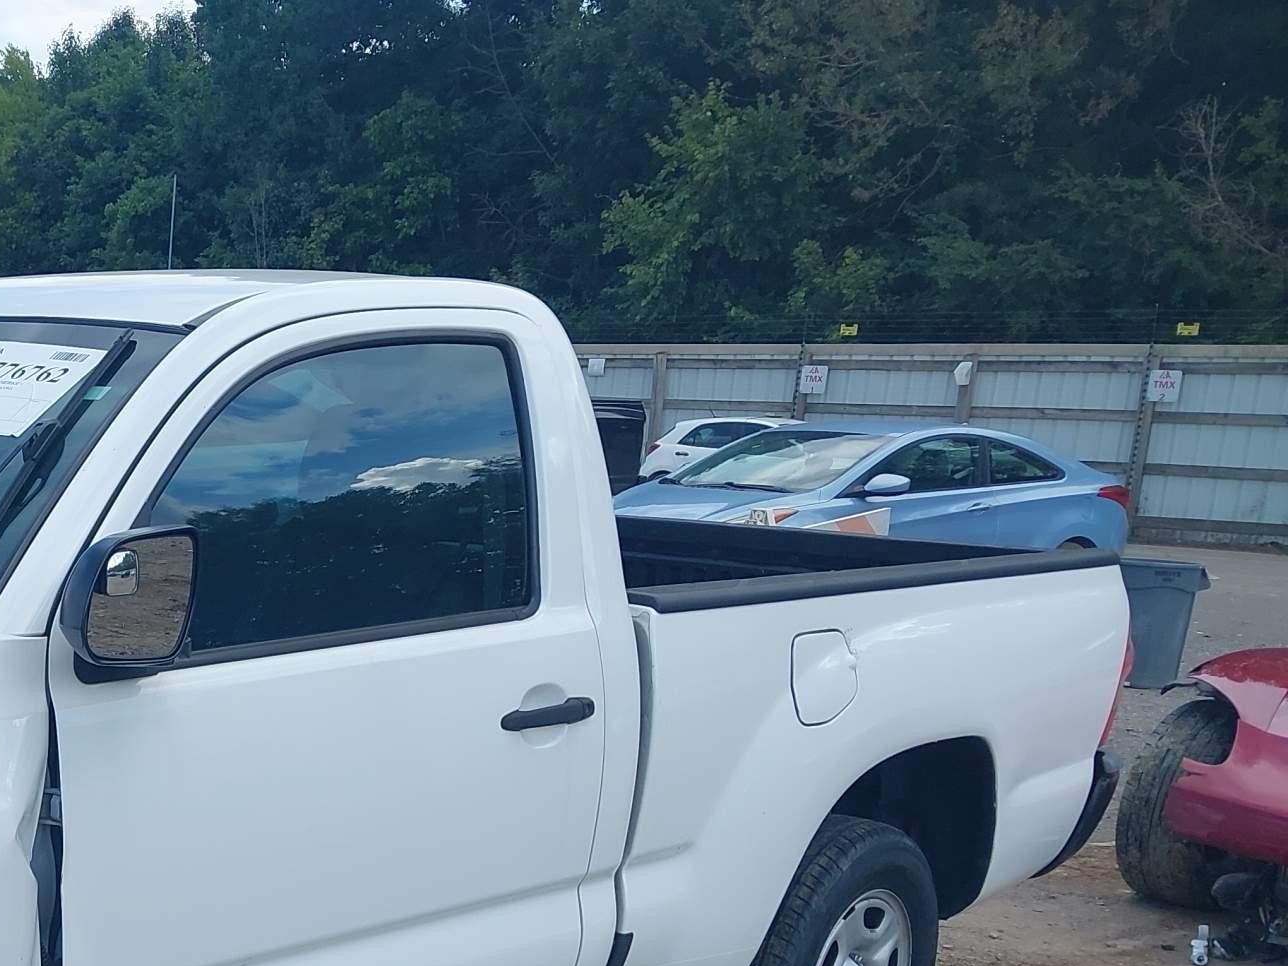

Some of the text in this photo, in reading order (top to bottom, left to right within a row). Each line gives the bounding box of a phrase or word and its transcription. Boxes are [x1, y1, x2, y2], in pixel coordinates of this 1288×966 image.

[804, 375, 824, 384] TMX
[1153, 381, 1176, 389] TMX
[1159, 393, 1166, 401] 2
